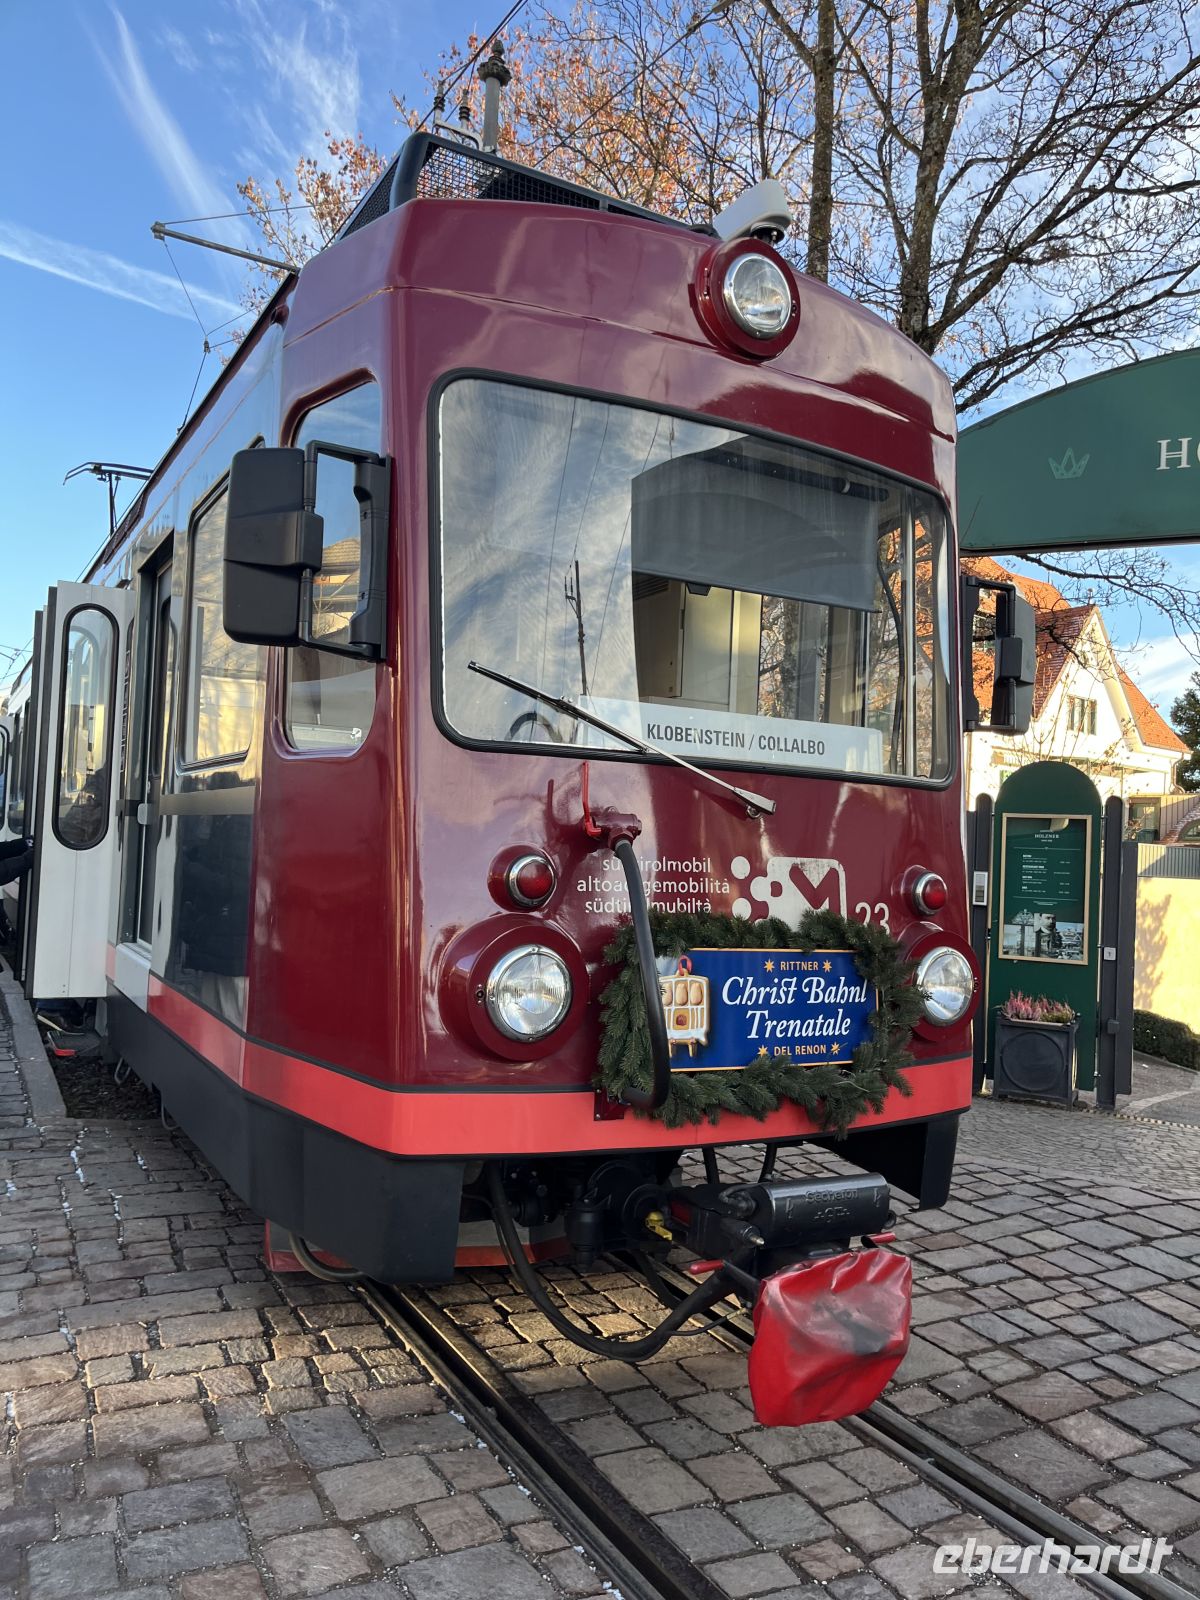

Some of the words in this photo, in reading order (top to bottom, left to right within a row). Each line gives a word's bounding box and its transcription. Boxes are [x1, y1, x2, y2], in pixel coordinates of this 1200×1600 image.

[1156, 437, 1200, 471] H
[647, 723, 745, 748] KLOBENSTEIN
[749, 734, 755, 751] /
[758, 735, 825, 756] COLLALBO
[602, 856, 711, 873] süirolmobil
[855, 901, 890, 936] 23
[780, 961, 819, 971] RITTNER
[722, 976, 797, 1006] Christ
[802, 976, 867, 1004] Bahnl
[746, 1009, 851, 1039] Trenatale
[774, 1045, 792, 1056] DEL
[795, 1045, 827, 1055] RENON
